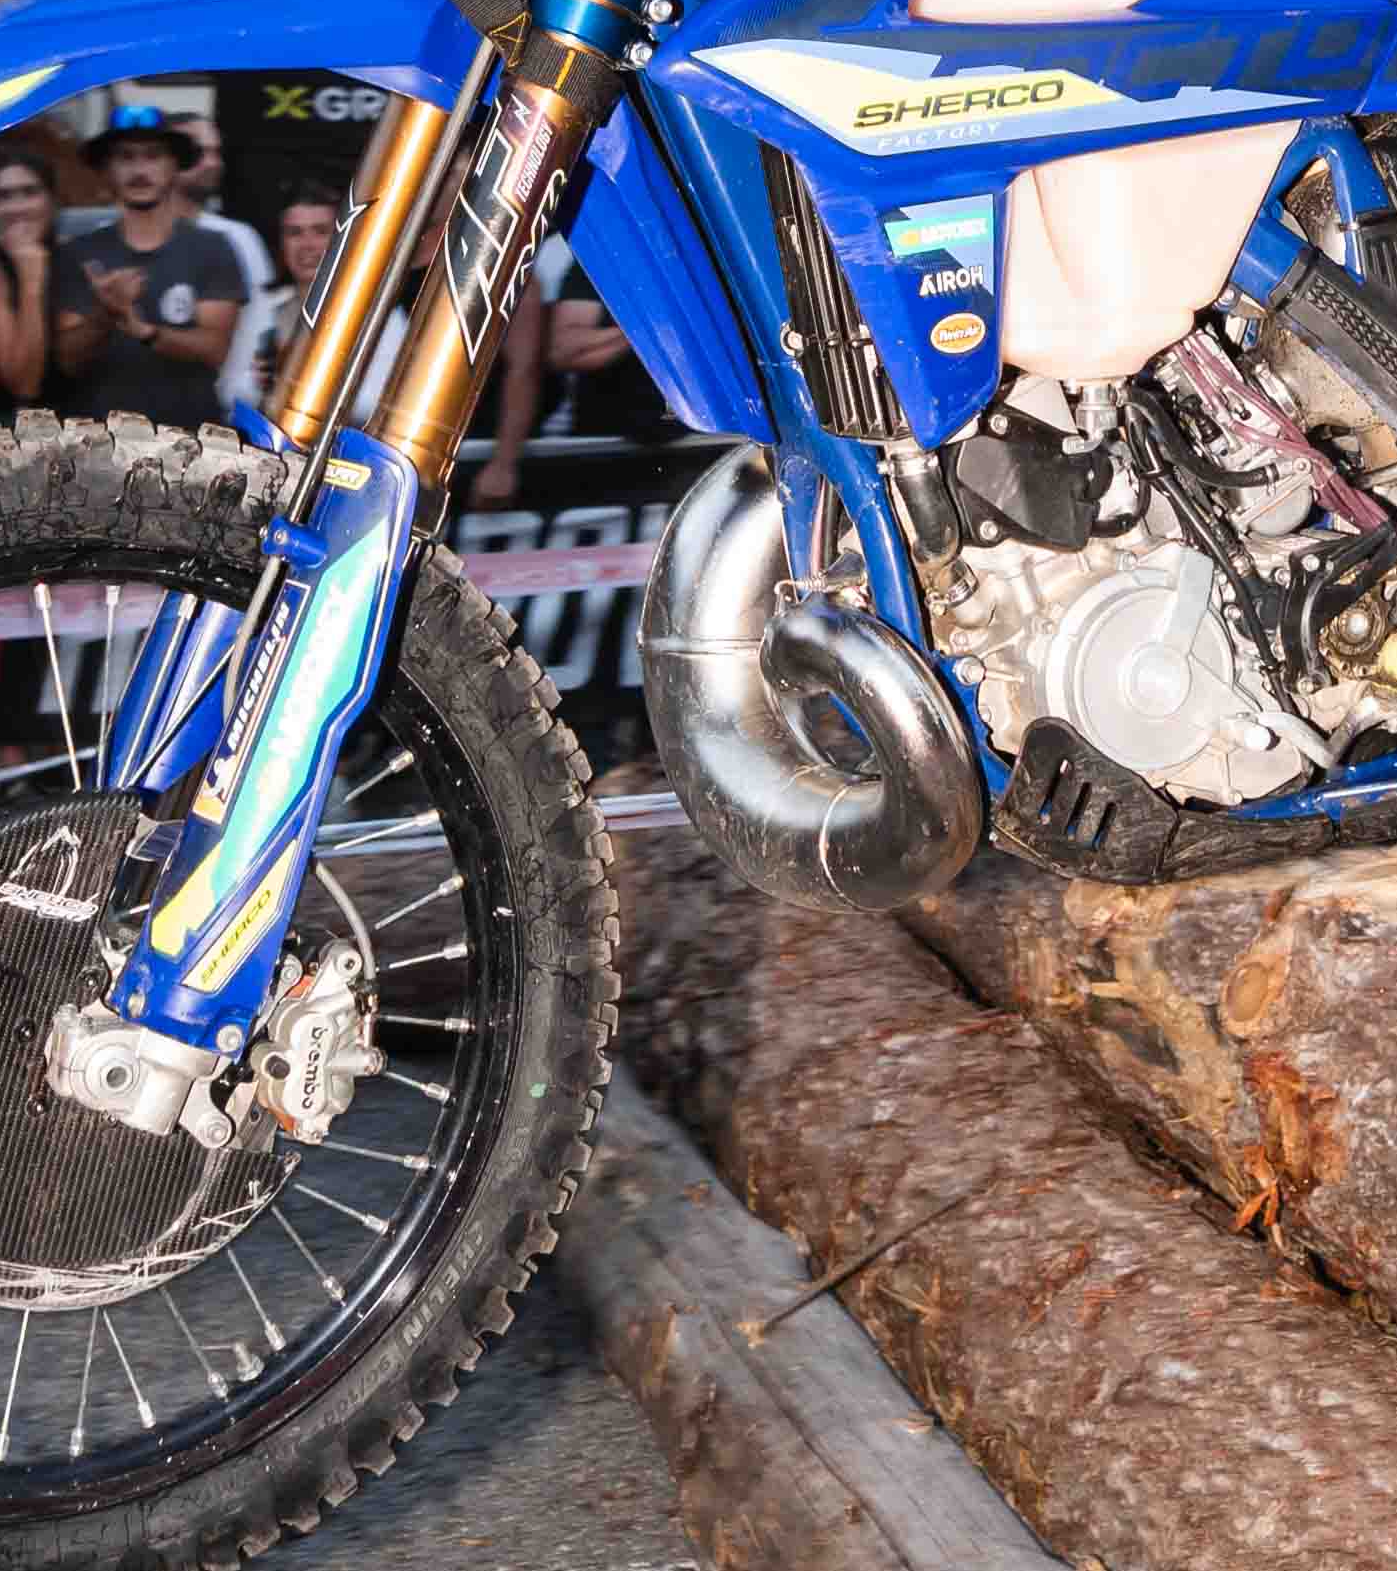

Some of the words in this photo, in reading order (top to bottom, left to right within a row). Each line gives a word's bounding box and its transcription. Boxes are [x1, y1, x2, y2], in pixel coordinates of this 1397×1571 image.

[852, 79, 1065, 130] SHERCO
[876, 121, 1001, 150] FACTORY
[514, 122, 554, 203] TECHNOLOGY
[919, 265, 984, 297] AIROH
[228, 599, 291, 751] MICHELIN
[200, 888, 272, 987] SHERCO
[301, 1025, 328, 1110] brembo
